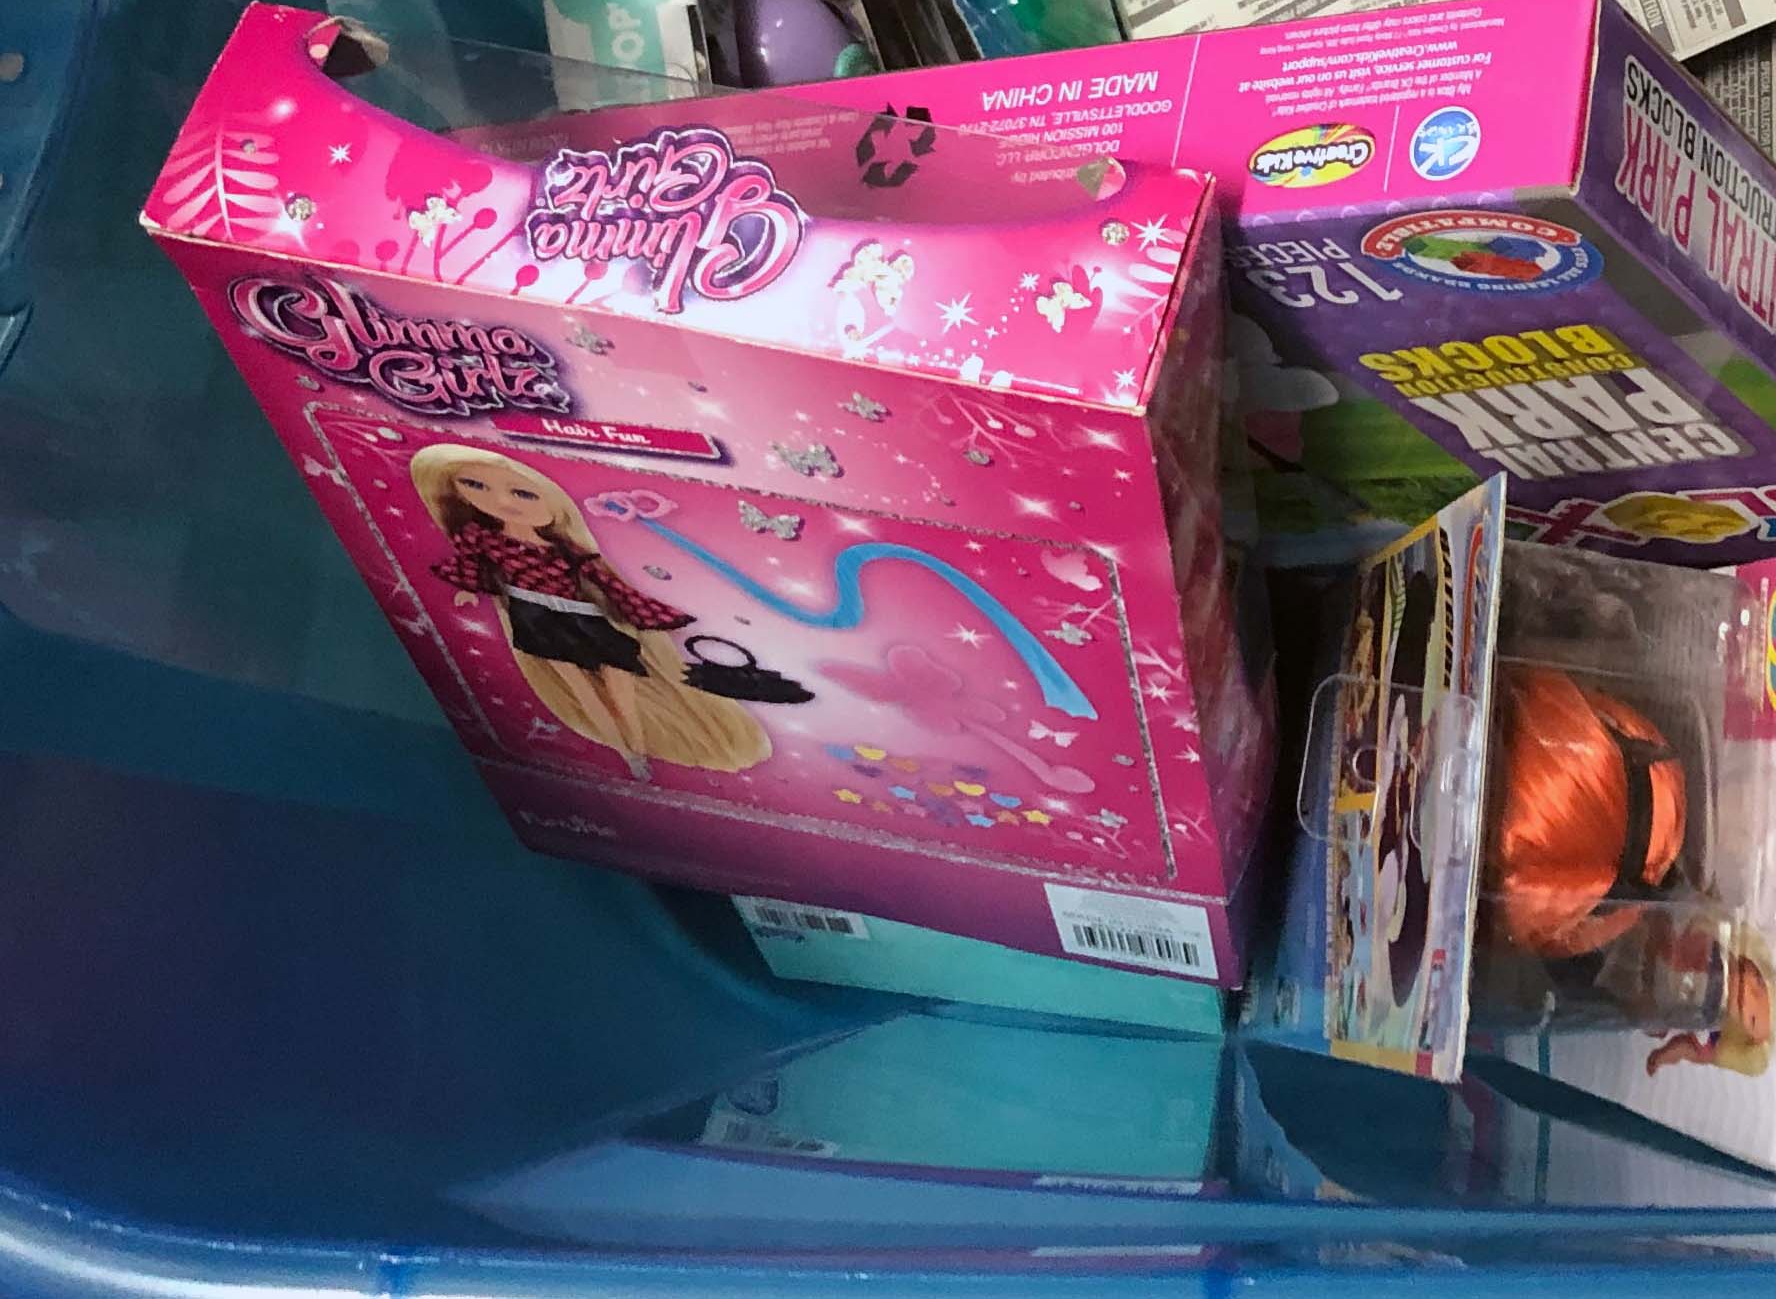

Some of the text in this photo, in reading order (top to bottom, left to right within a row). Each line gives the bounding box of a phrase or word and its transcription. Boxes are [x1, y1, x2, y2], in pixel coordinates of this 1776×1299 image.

[1311, 24, 1339, 37] picture
[1381, 16, 1401, 28] may
[1427, 10, 1444, 23] and
[1237, 50, 1492, 93] For customer service, visit us on our website at
[1281, 39, 1458, 72] www.CreativeKids.com/support
[980, 70, 1159, 111] MADE IN CHINA
[1624, 63, 1703, 156] BLOCKS
[1759, 61, 1769, 147] SPECIAL COLLECTOR
[1028, 113, 1046, 127] TN
[1042, 124, 1099, 143] MISSION
[1099, 121, 1123, 136] 100
[554, 142, 728, 219] Girlz
[1619, 104, 1705, 251] PARK
[532, 176, 799, 313] Glimma
[1374, 218, 1558, 251] COMPATIBLE
[1245, 261, 1403, 309] 123
[1392, 262, 1557, 290] LEADING BRANDS
[232, 277, 534, 370] Glimma
[1357, 321, 1613, 384] BLOCKS
[370, 354, 538, 402] Girlz
[1392, 352, 1633, 398] CONSTRUCTION
[1407, 367, 1702, 449] PARK
[541, 418, 652, 446] Hair Fun
[1479, 421, 1740, 480] CENTRAL
